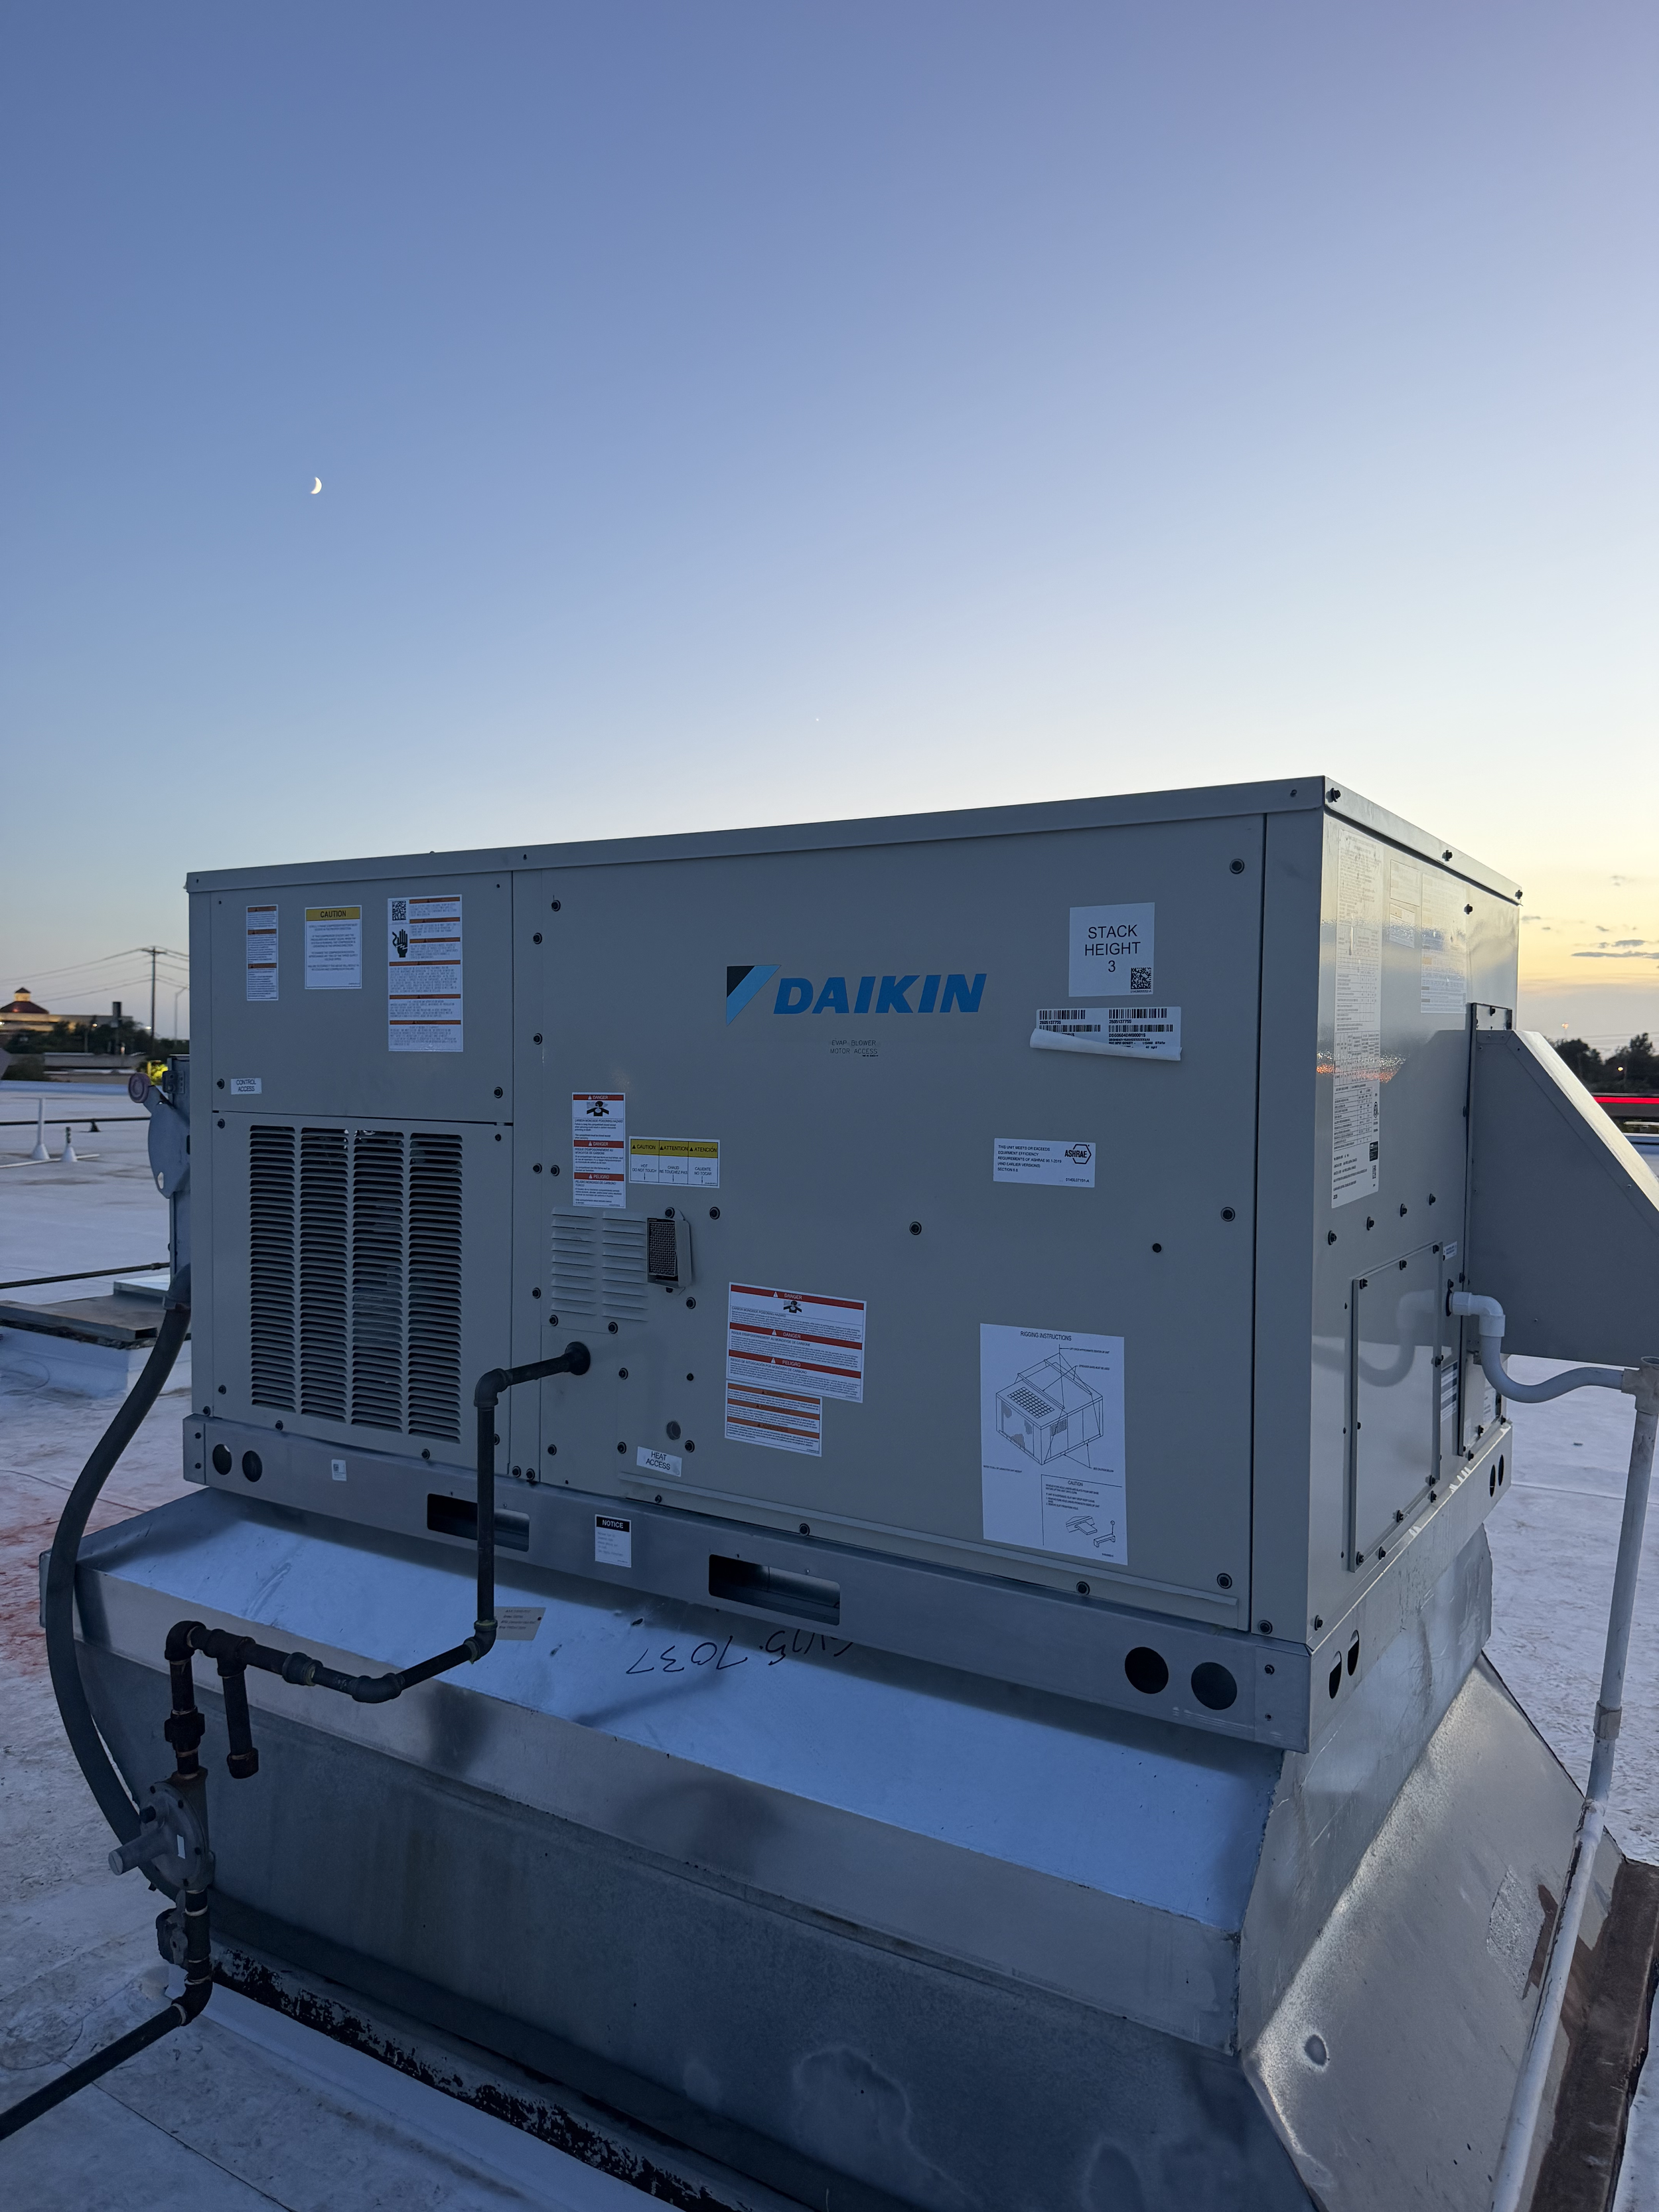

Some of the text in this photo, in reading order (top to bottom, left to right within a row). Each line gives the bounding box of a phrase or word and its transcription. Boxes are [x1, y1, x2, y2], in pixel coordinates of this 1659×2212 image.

[1088, 924, 1138, 939] STACK
[1085, 942, 1141, 956] HEIGHT
[1108, 960, 1116, 972] 3
[773, 974, 987, 1014] DAIKIN
[1039, 1332, 1072, 1341] INSTRUCTIONS
[651, 1451, 667, 1461] HEAT
[646, 1458, 670, 1470] ACCESS
[602, 1520, 624, 1528] NOTICE
[626, 1635, 748, 1674] 7037
